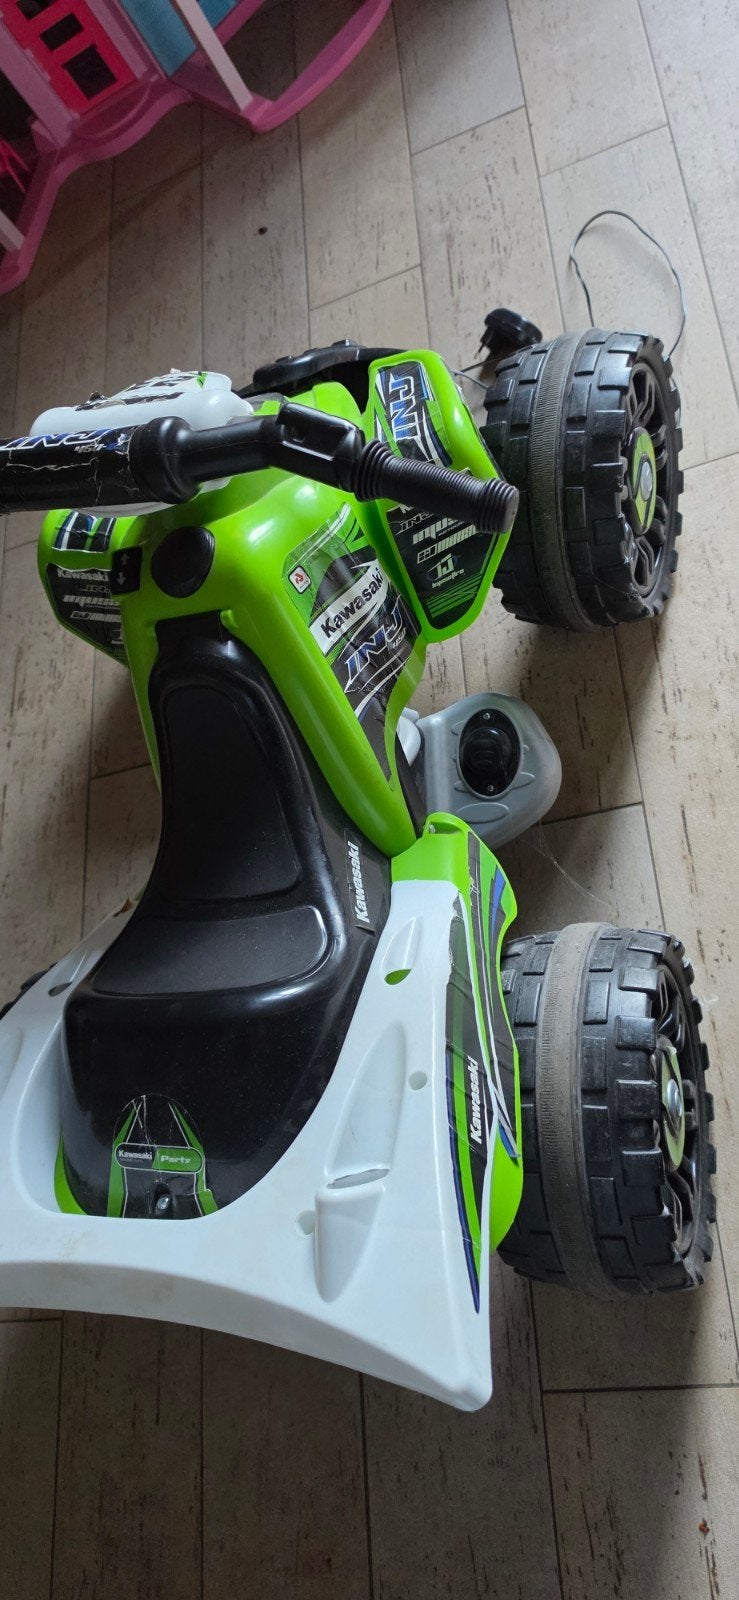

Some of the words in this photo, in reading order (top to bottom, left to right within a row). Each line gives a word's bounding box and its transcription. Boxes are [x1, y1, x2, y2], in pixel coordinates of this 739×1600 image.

[57, 568, 109, 582] Kawasaki
[320, 569, 384, 639] Kawasaki
[348, 841, 371, 924] Kawasaki
[469, 1056, 482, 1144] Kawasaki
[118, 1149, 153, 1160] Kawasaki
